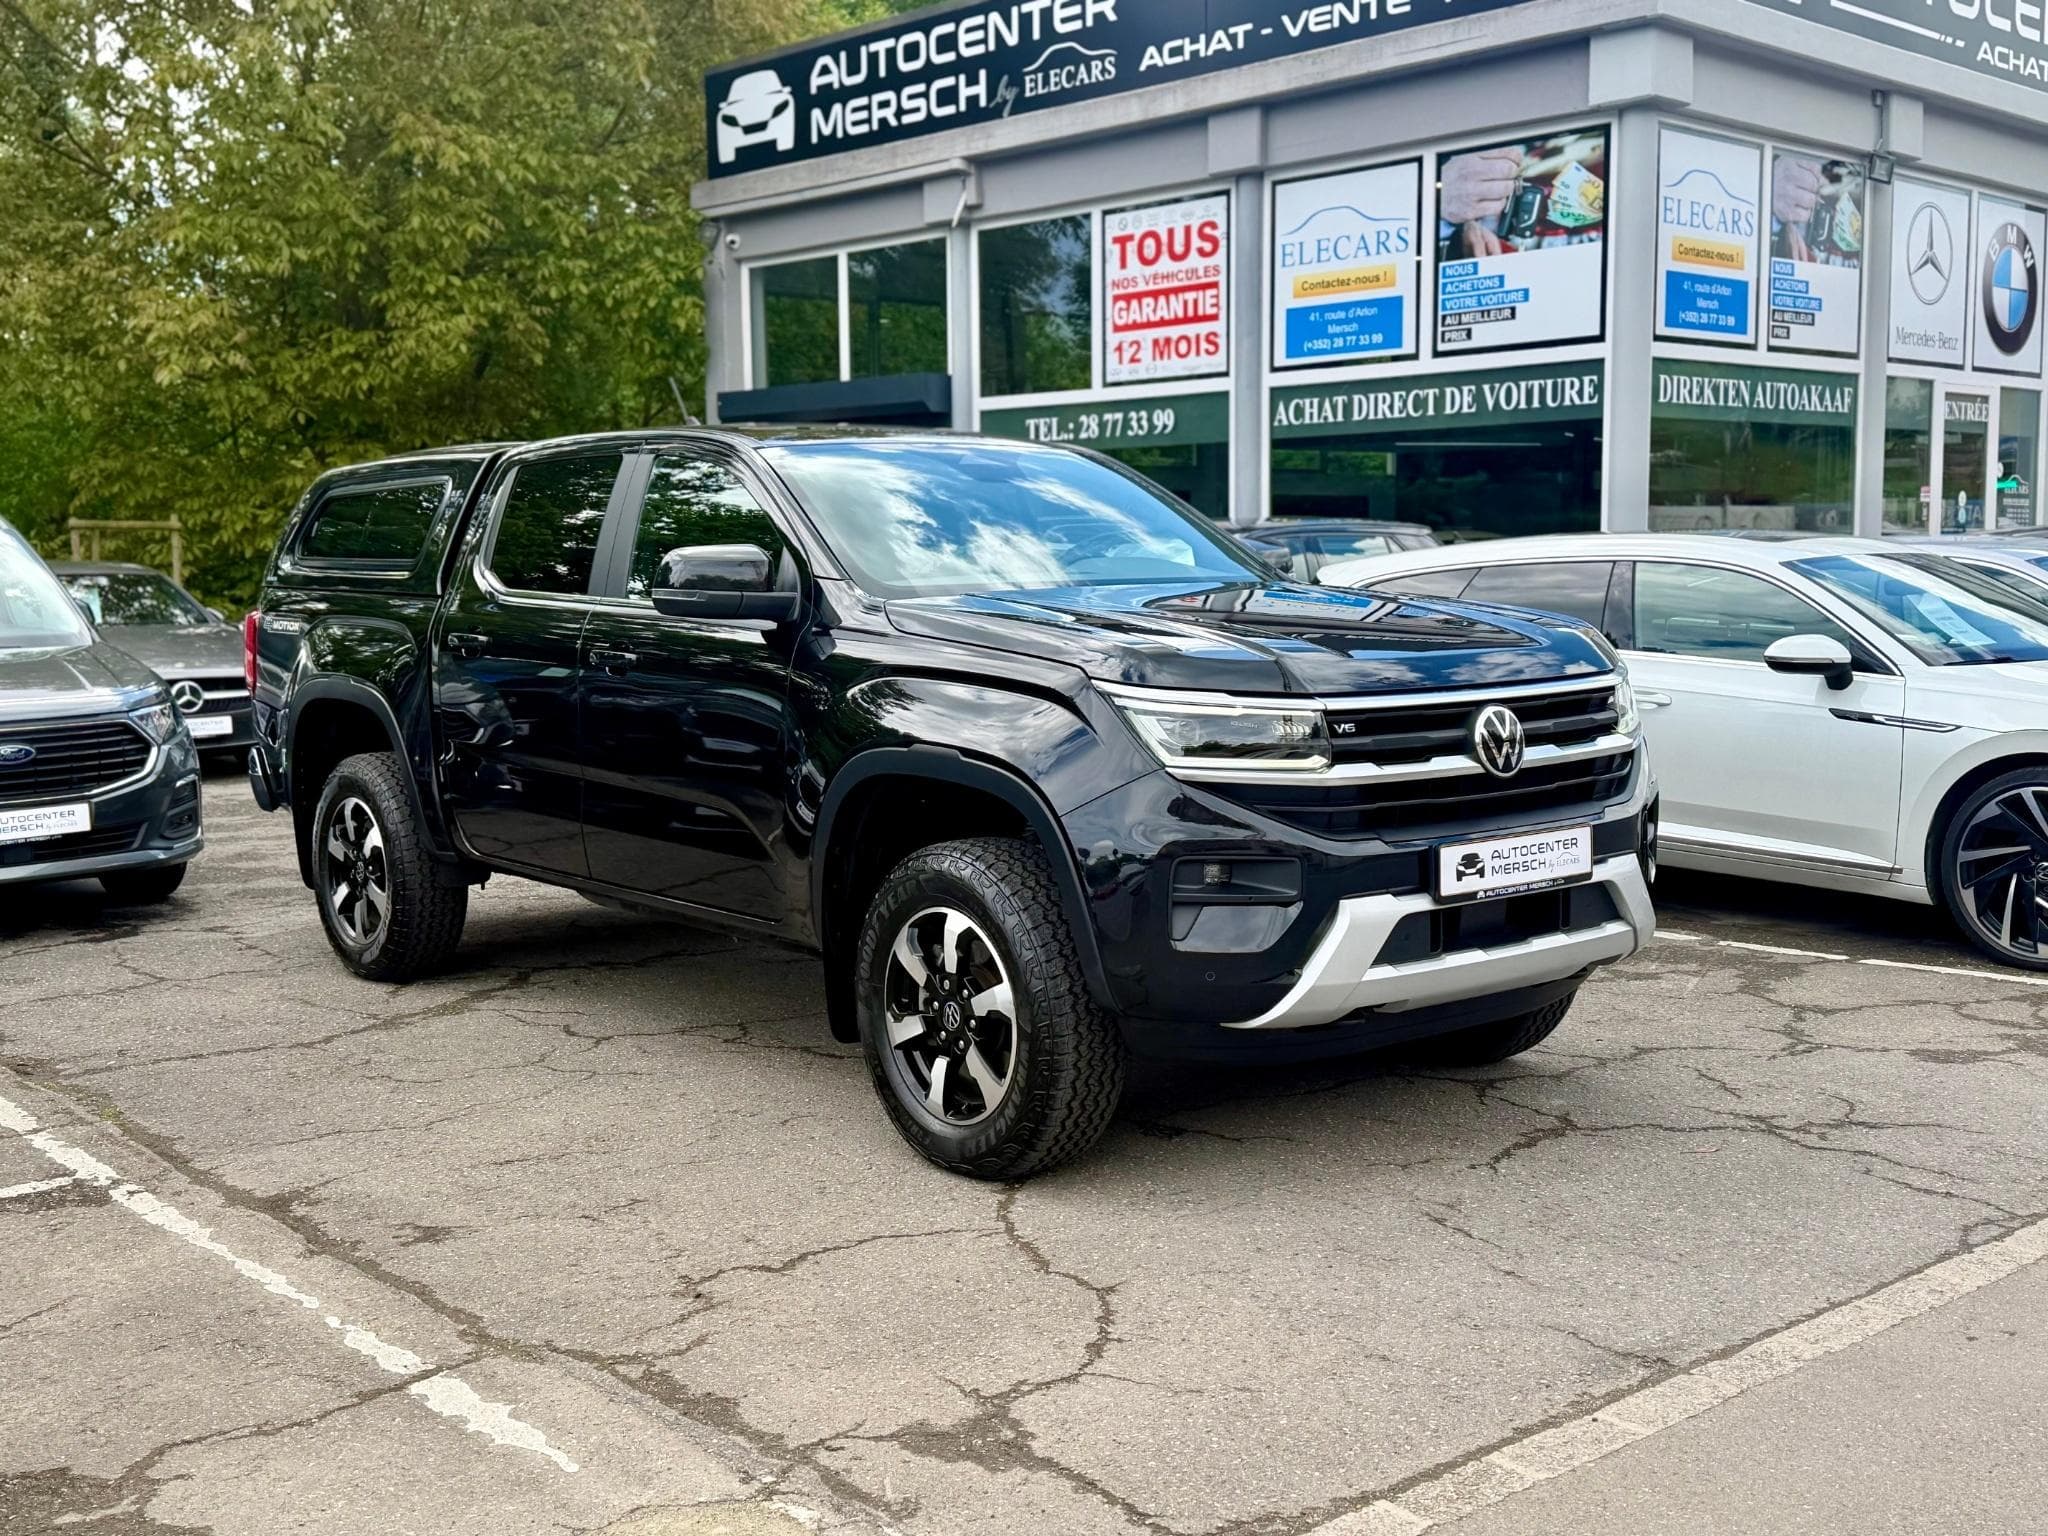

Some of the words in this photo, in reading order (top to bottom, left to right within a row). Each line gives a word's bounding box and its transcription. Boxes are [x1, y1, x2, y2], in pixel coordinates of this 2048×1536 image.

[809, 0, 1118, 95] AUTOCENTER
[1139, 25, 1253, 72] ACHAT
[1024, 56, 1116, 98] ELECARS
[810, 69, 988, 144] MERSCH
[989, 74, 1019, 118] by
[1663, 196, 1754, 238] ELECARS
[1112, 220, 1220, 270] TOUS
[1281, 227, 1410, 268] ELECARS
[1678, 243, 1735, 263] Contactez-nous
[1990, 224, 2035, 268] BMW
[1445, 263, 1474, 276] NOUS
[1774, 262, 1792, 274] NOUS
[1111, 276, 1138, 291] NOS
[1301, 273, 1381, 292] Contactez-nous
[1445, 277, 1500, 292] ACHETONS
[1113, 289, 1218, 326] GARANTIE
[1445, 296, 1479, 309] VOTRE
[1480, 291, 1525, 305] VOITURE
[1324, 310, 1346, 321] route
[1444, 314, 1459, 325] AU
[1461, 308, 1512, 324] MEILLEUR
[1328, 322, 1359, 334] Mersch
[1444, 330, 1468, 342] PRIX
[1113, 340, 1142, 365] 12
[1152, 332, 1220, 361] MOIS
[1304, 338, 1331, 352] (+352)
[1333, 337, 1344, 348] 28
[1346, 336, 1357, 346] 77
[1359, 334, 1370, 345] 33
[1371, 332, 1383, 344] 99
[1895, 326, 1959, 351] Mercedes-Benz
[1274, 395, 1347, 427] ACHAT
[1352, 388, 1439, 426] DIRECT
[1444, 385, 1477, 414] DE
[1482, 375, 1598, 411] VOITURE
[1658, 374, 1750, 408] DIREKTEN
[1752, 381, 1854, 414] AUTOAKAAF
[1945, 398, 1990, 423] ENTRÉE
[1079, 415, 1099, 439] 28
[1103, 412, 1124, 437] 77
[1127, 411, 1148, 436] 33
[1152, 408, 1175, 434] 99
[1333, 723, 1357, 734] V6
[0, 810, 75, 825] UTOCENTER
[0, 823, 44, 834] ERSCH
[1491, 837, 1579, 861] AUTOCENTER
[1491, 858, 1547, 877] MERSCH
[1486, 885, 1528, 897] AUTOCENTER
[1529, 880, 1554, 890] MERSCH
